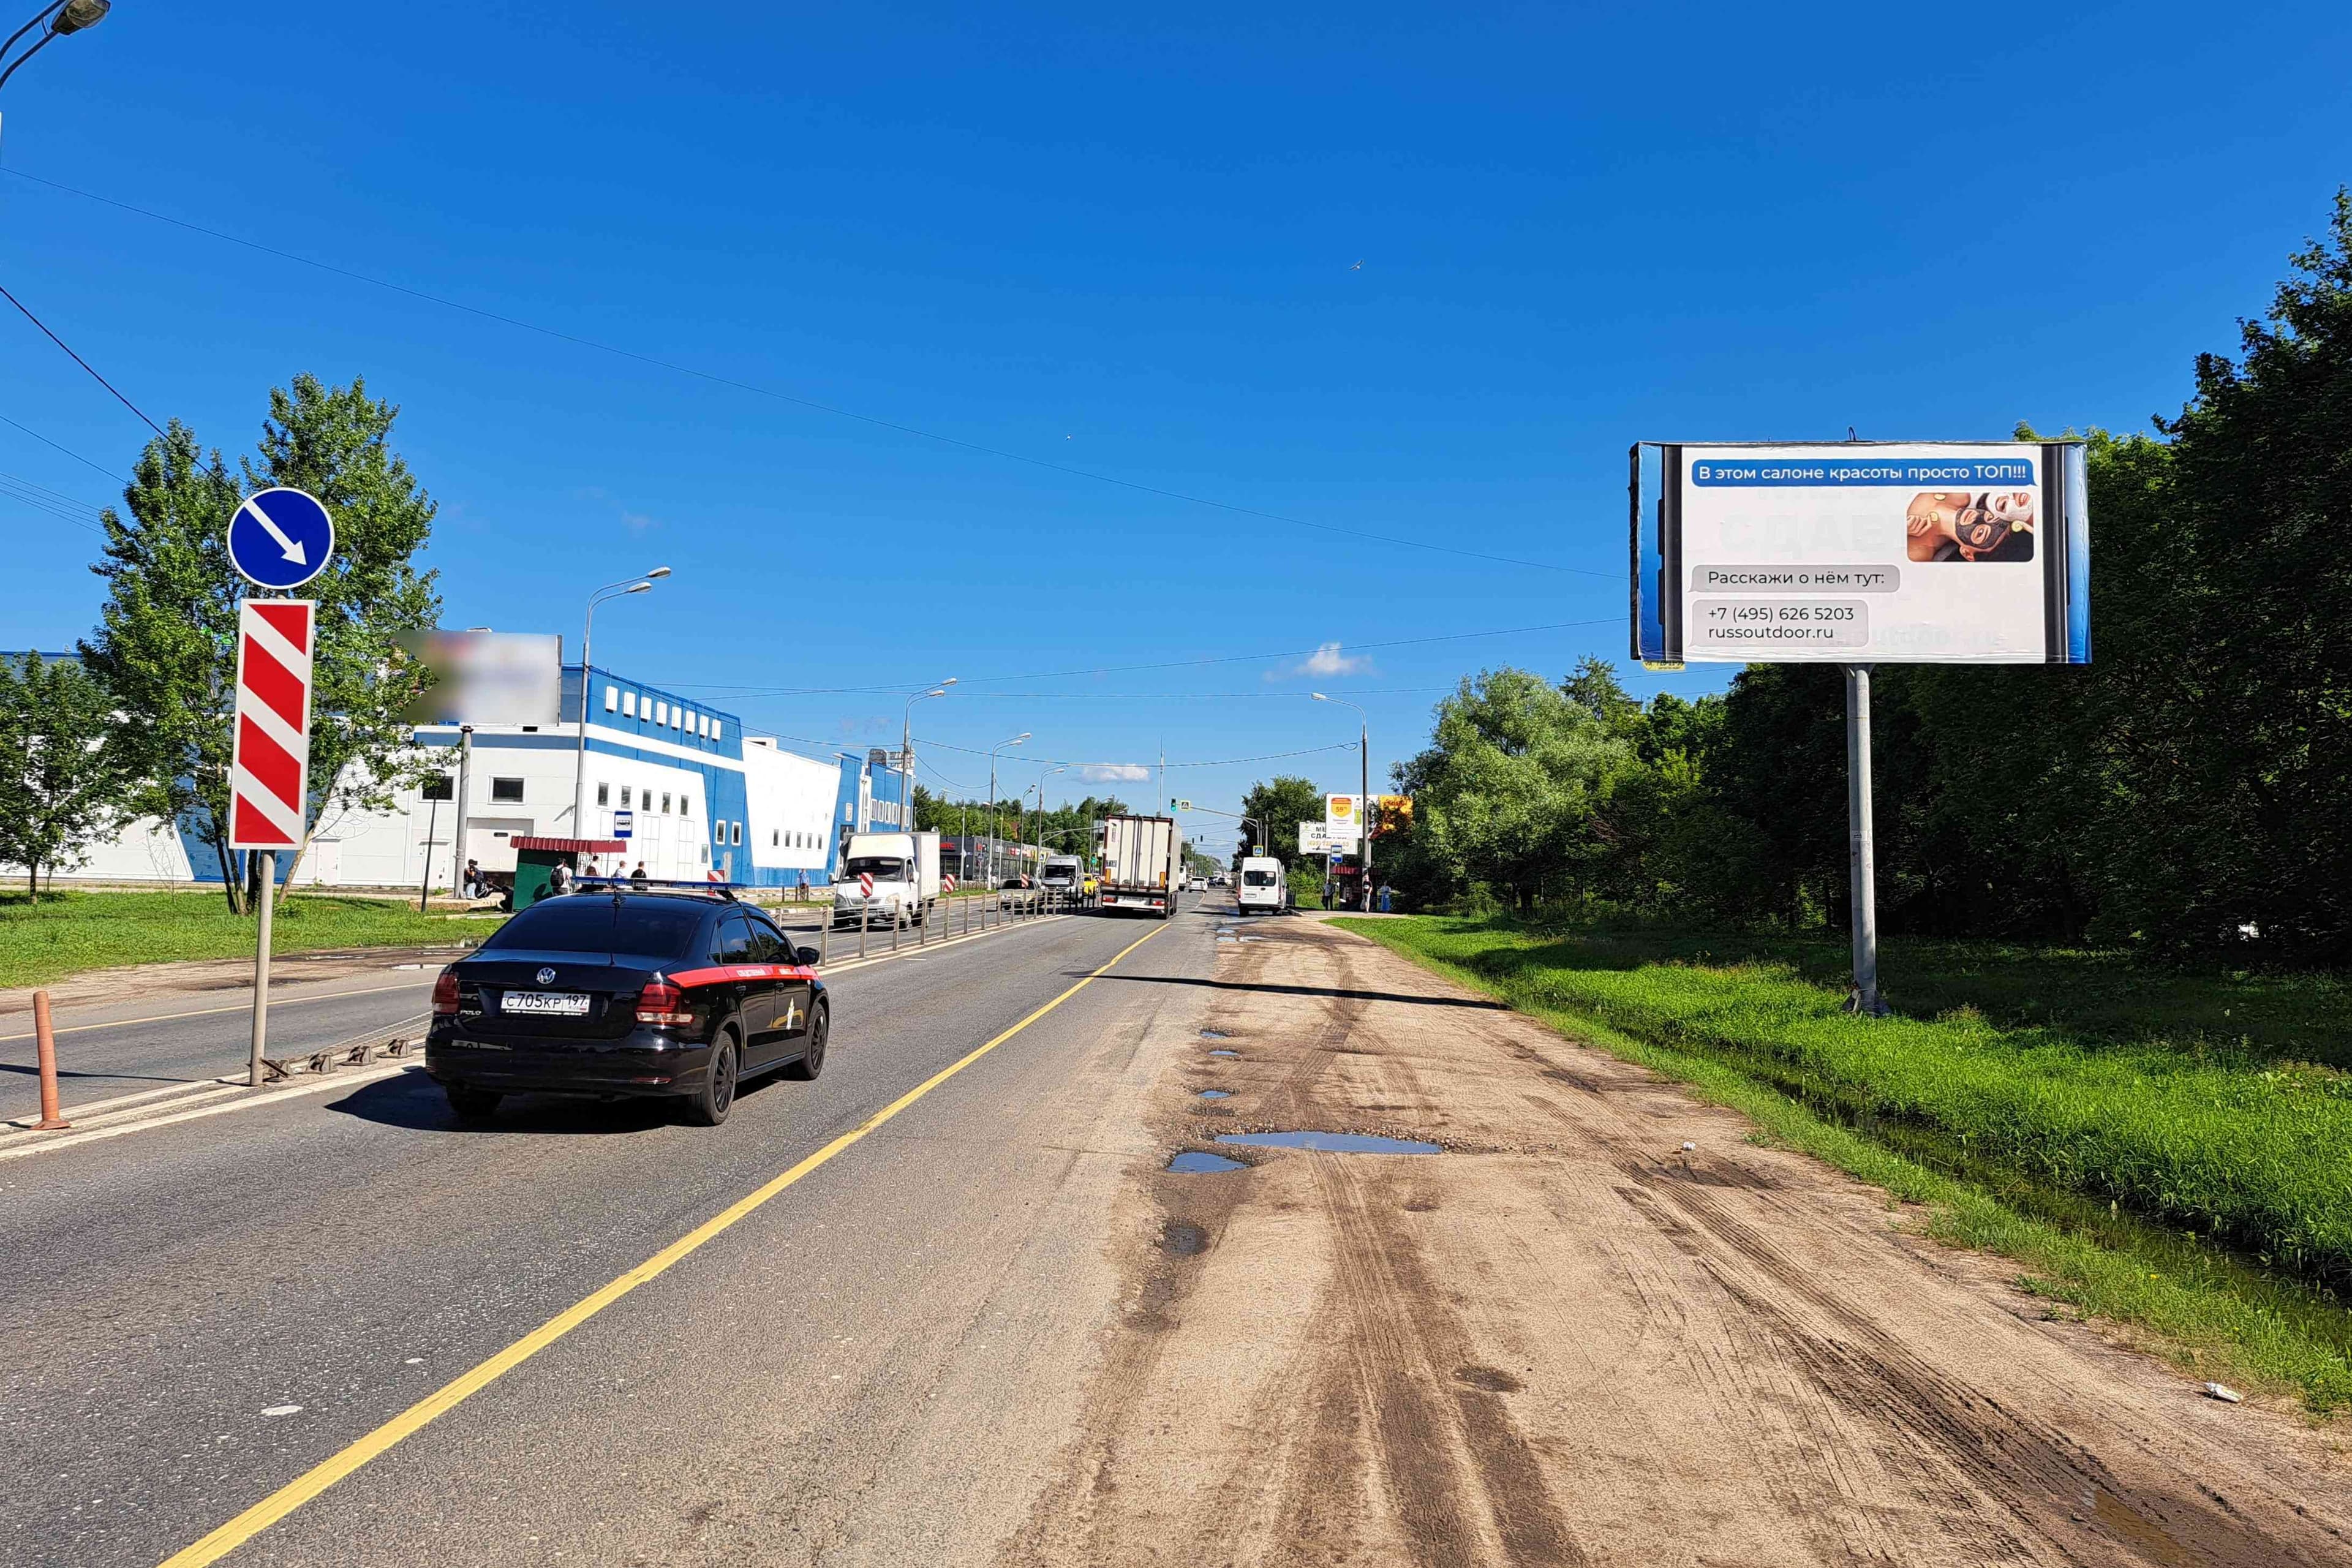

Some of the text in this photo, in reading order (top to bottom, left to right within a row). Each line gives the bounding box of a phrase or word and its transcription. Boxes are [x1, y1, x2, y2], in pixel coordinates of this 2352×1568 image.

[1698, 464, 2027, 481] В этом салоне красоты просто ТОП!!!
[1708, 570, 1885, 587] Расскажи о нём тут:
[1708, 606, 1854, 623] +7 (495) 626 5203
[1708, 625, 1833, 638] russoutdoor.ru
